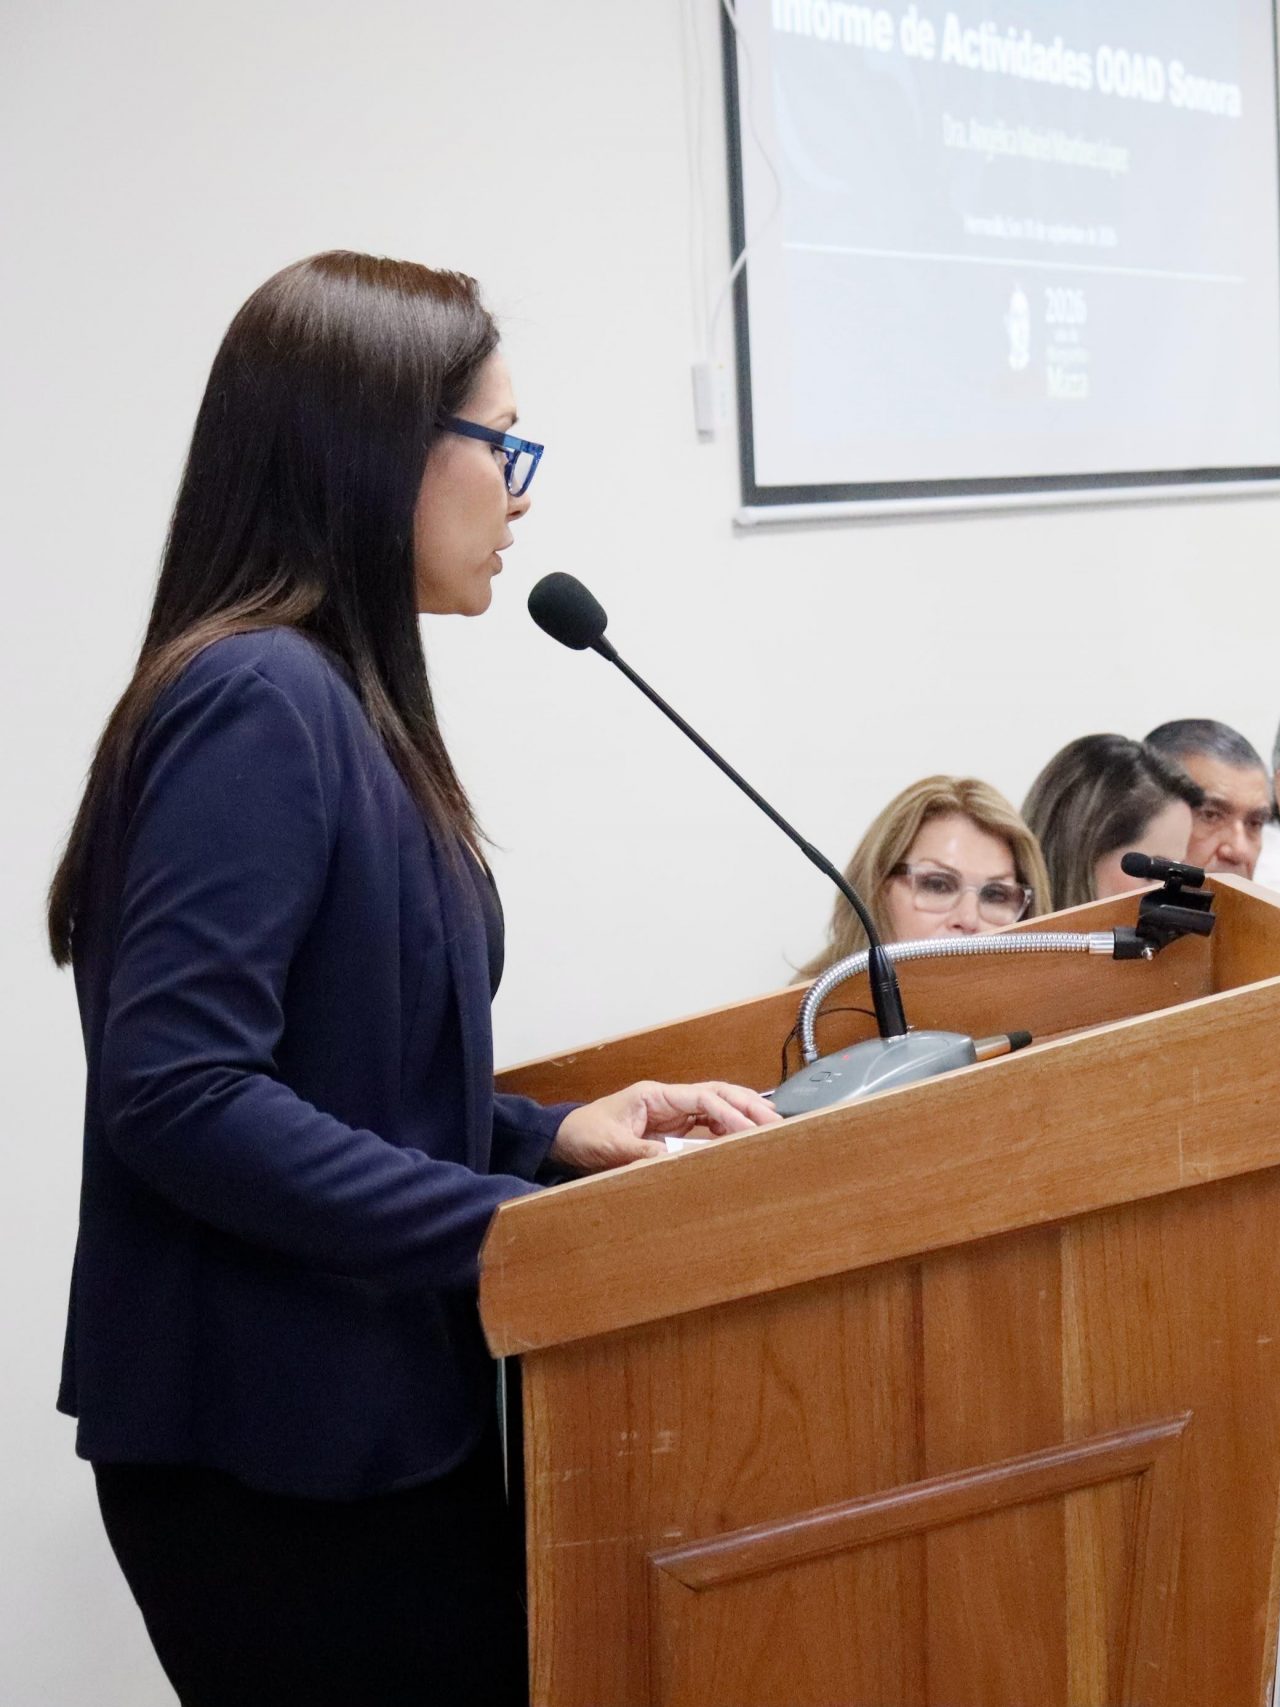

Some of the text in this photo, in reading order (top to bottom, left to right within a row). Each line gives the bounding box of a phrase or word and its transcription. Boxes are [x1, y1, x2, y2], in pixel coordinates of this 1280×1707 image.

[771, 0, 895, 52] Informe
[900, 3, 936, 60] de
[941, 12, 1093, 91] Actividades
[1168, 59, 1243, 118] Sonora
